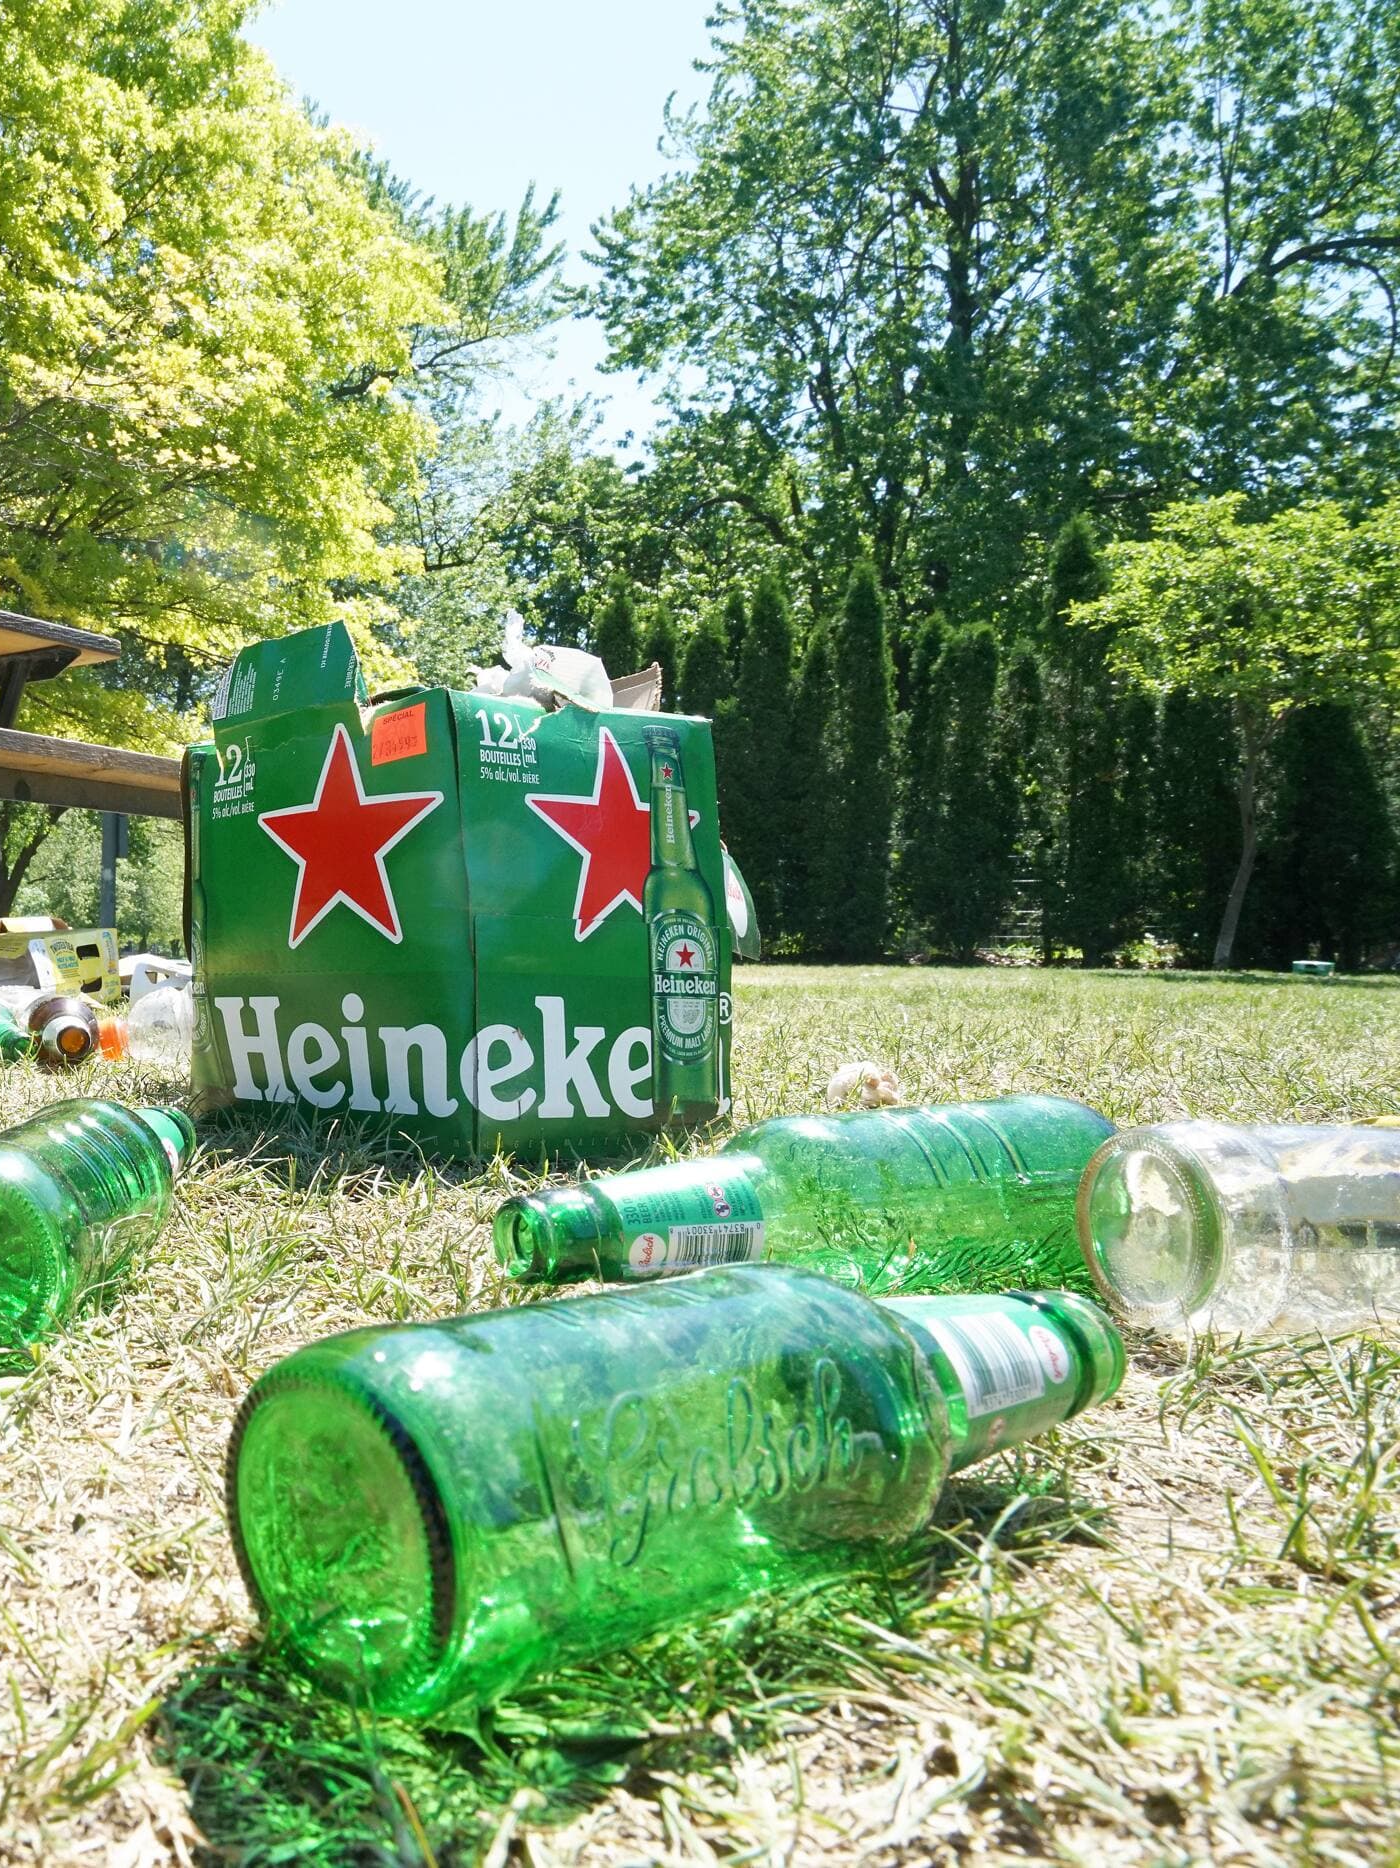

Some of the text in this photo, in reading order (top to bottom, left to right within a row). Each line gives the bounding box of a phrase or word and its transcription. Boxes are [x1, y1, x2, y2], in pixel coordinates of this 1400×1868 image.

[474, 708, 517, 750] 12
[523, 736, 537, 751] 330
[214, 744, 242, 787] 12
[479, 748, 522, 767] BOUTEILLES
[480, 766, 494, 780] 5%
[522, 771, 540, 785] BIÈRE
[213, 786, 243, 803] BOUTEILLES
[211, 807, 222, 820] 5%
[241, 800, 255, 814] BIÈRE
[664, 784, 676, 844] Heineken
[656, 924, 714, 963] HEINEKEN ORIGINAL
[653, 974, 717, 995] Heineken
[658, 1015, 685, 1049] PREMIUM
[684, 1035, 701, 1049] MALT
[214, 993, 731, 1122] Heineke
[623, 1206, 641, 1226] 330
[638, 1202, 653, 1225] BEER
[686, 1226, 714, 1236] 33001
[718, 1223, 746, 1234] 83741
